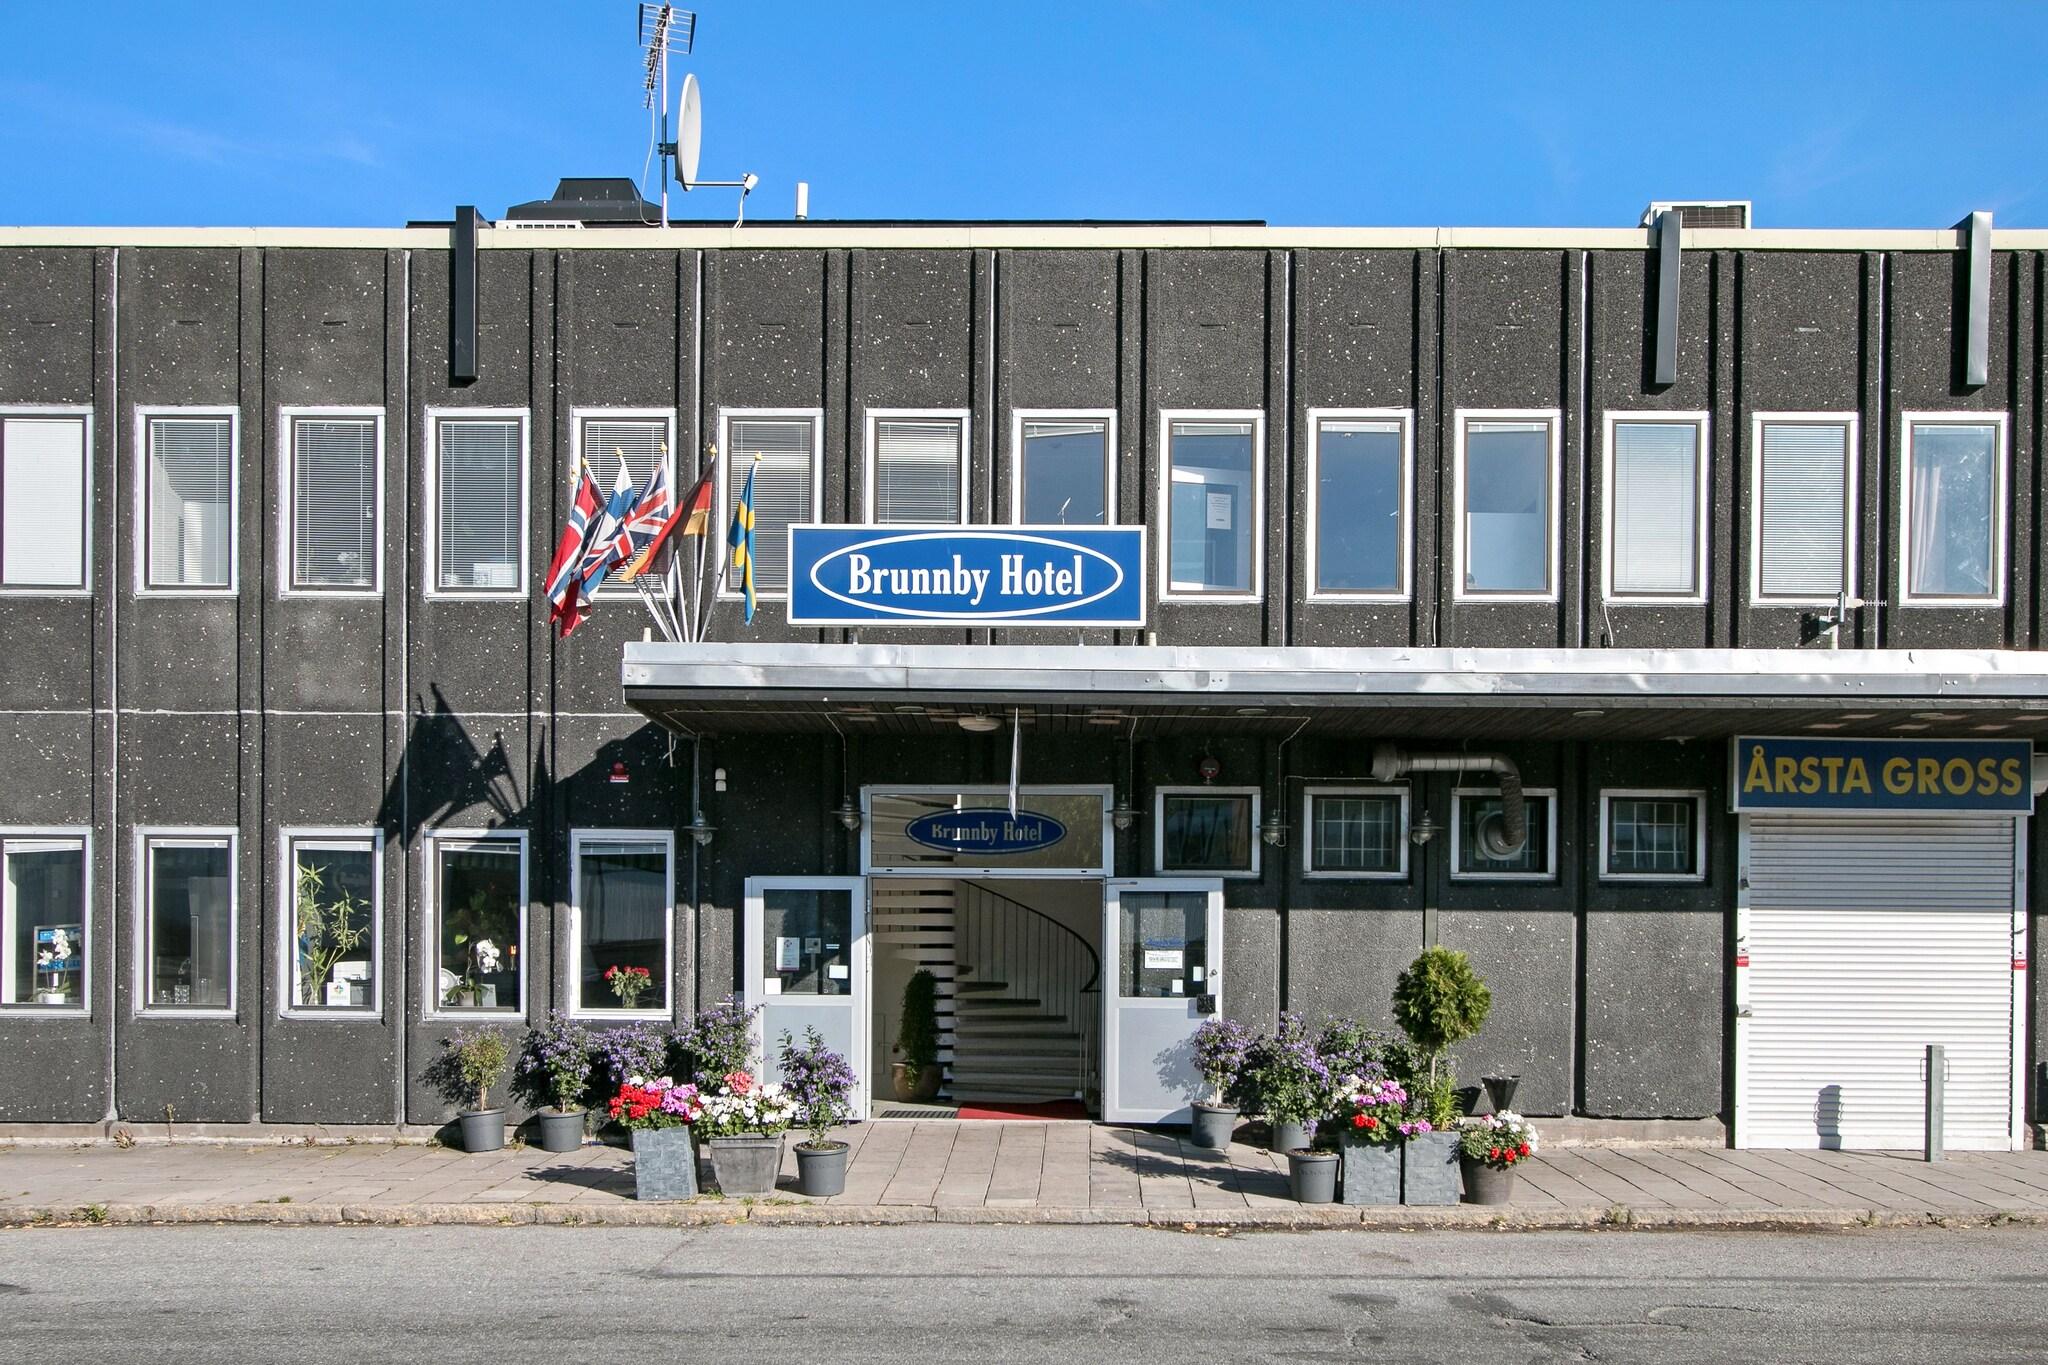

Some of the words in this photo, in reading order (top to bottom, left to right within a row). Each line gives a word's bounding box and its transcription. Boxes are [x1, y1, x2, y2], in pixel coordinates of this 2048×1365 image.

[848, 554, 991, 606] Brunnby
[1000, 554, 1084, 596] Hotel
[1743, 745, 1873, 795] ÅRSTA
[1882, 757, 2023, 796] GROSS
[1003, 820, 1043, 842] Hotel
